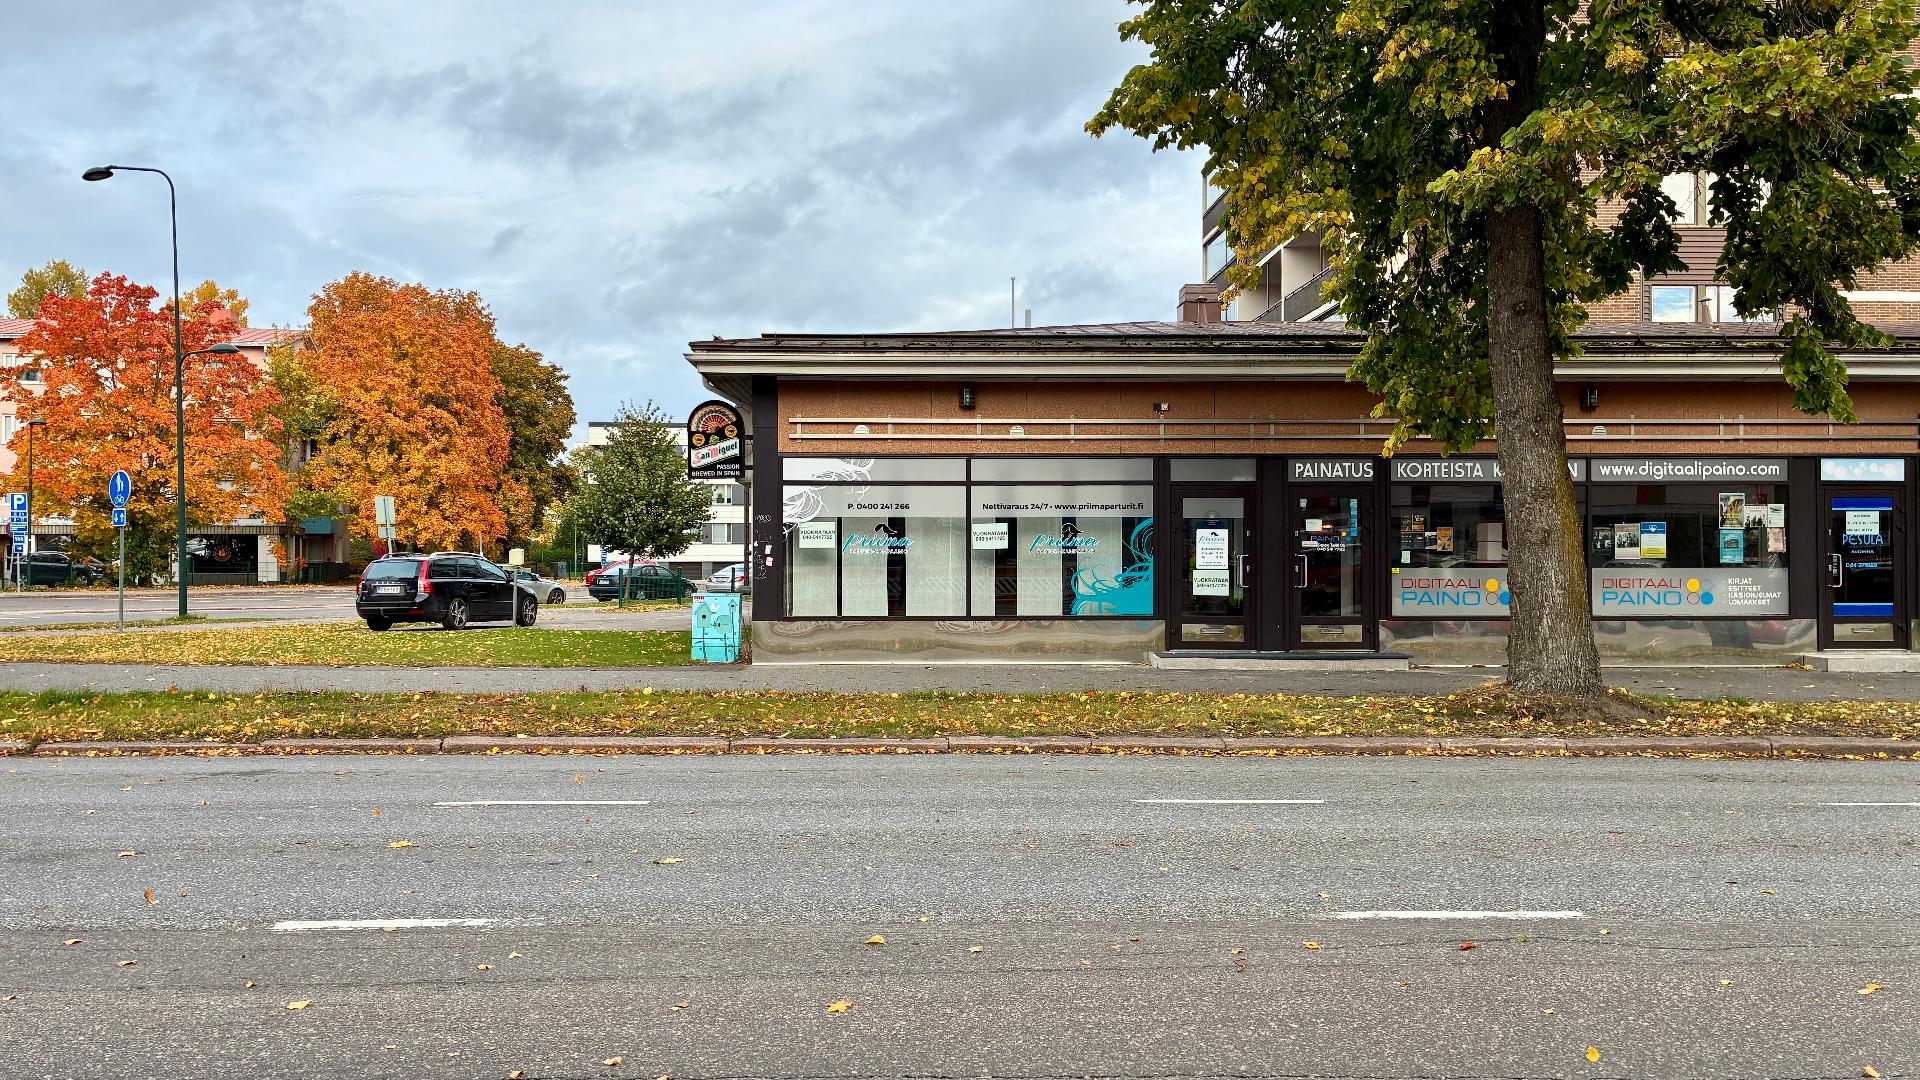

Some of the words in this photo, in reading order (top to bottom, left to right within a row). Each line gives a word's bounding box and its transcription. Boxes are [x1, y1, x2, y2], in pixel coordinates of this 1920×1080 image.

[692, 452, 710, 464] San
[710, 441, 737, 459] Miguel
[1295, 462, 1373, 478] PAINATUS
[1397, 462, 1483, 478] KORTEISTA
[1599, 461, 1780, 479] www.digitaalipaino.com
[13, 494, 24, 509] P
[1054, 503, 1144, 511] www.priimaparturit.fi
[1842, 533, 1884, 545] PESULA
[1401, 578, 1481, 589] DIGITAALI
[1602, 578, 1682, 589] DIGITAALI
[1401, 591, 1481, 606] PAINO
[1602, 591, 1682, 606] PAINO
